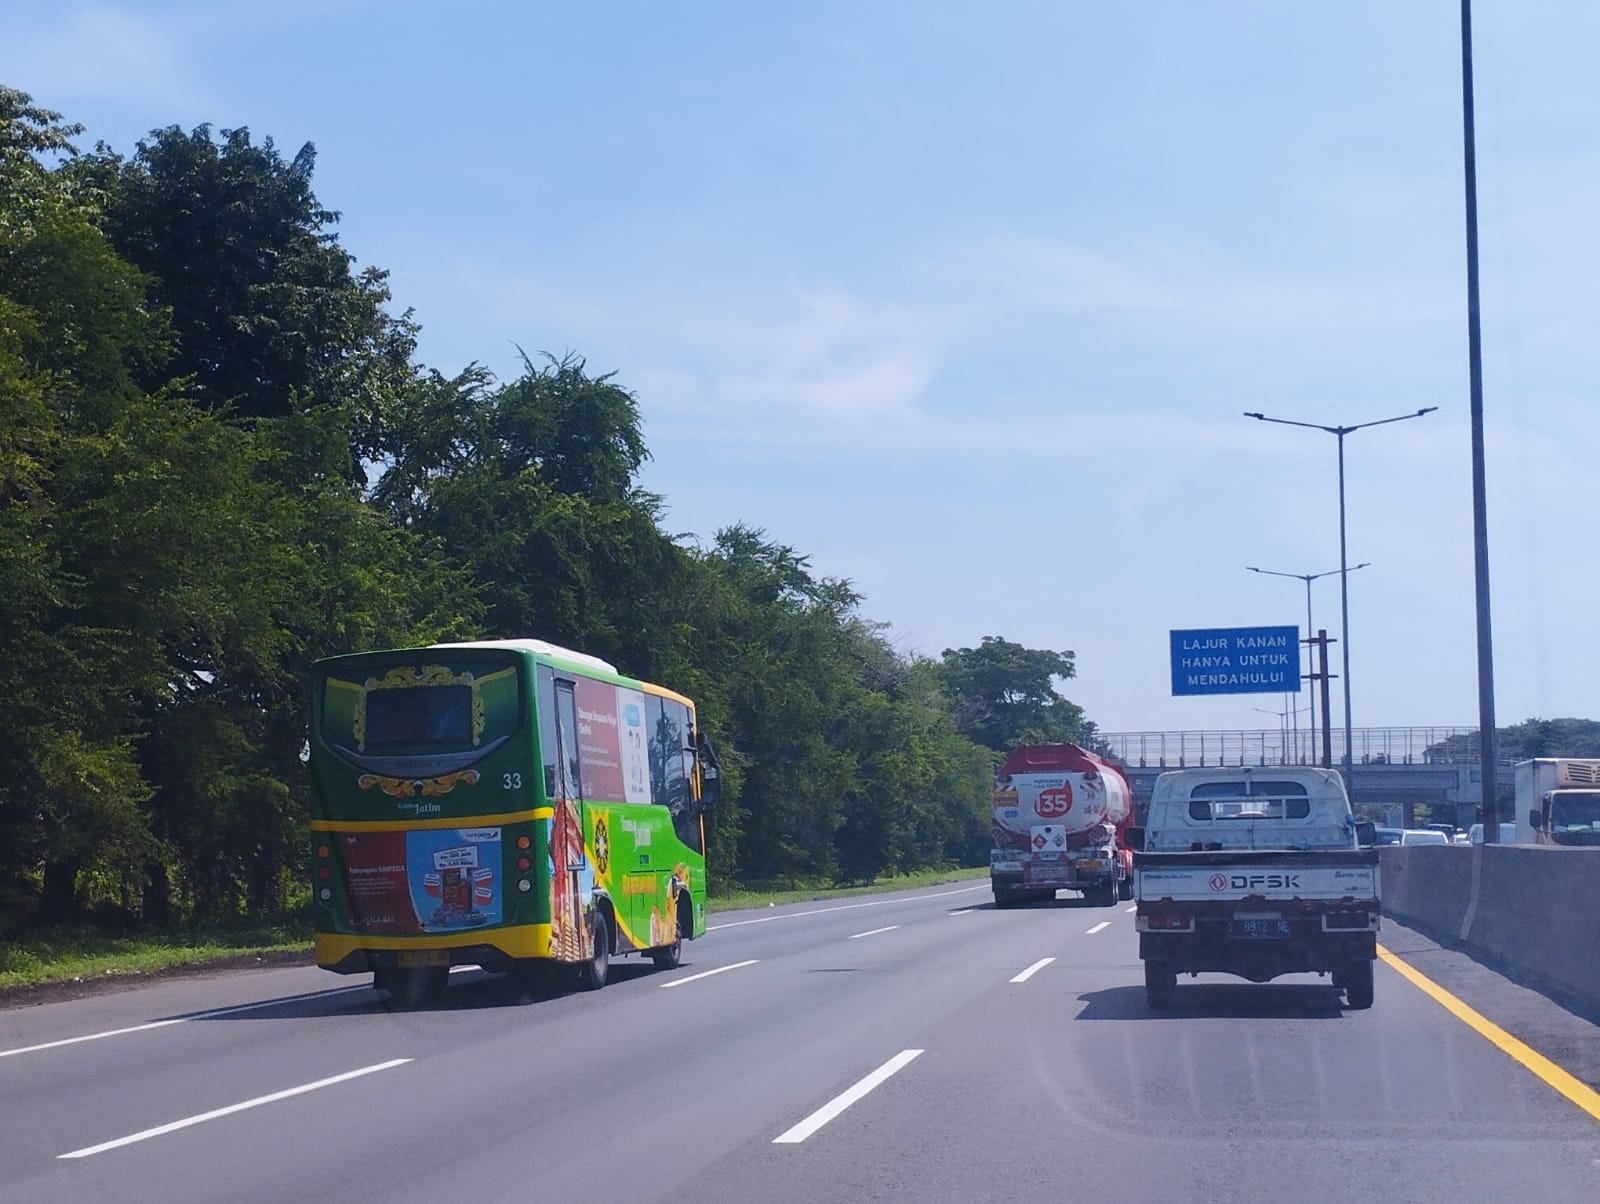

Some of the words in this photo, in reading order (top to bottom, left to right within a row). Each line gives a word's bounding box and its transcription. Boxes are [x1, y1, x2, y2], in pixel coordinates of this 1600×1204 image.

[1183, 638, 1228, 650] LAJUR
[1236, 636, 1287, 648] KANAN
[1182, 656, 1231, 668] HANYA
[1239, 653, 1289, 666] UNTUK
[1188, 671, 1284, 686] MENDAHULUI
[503, 772, 522, 789] 33
[1231, 874, 1300, 889] DFSK
